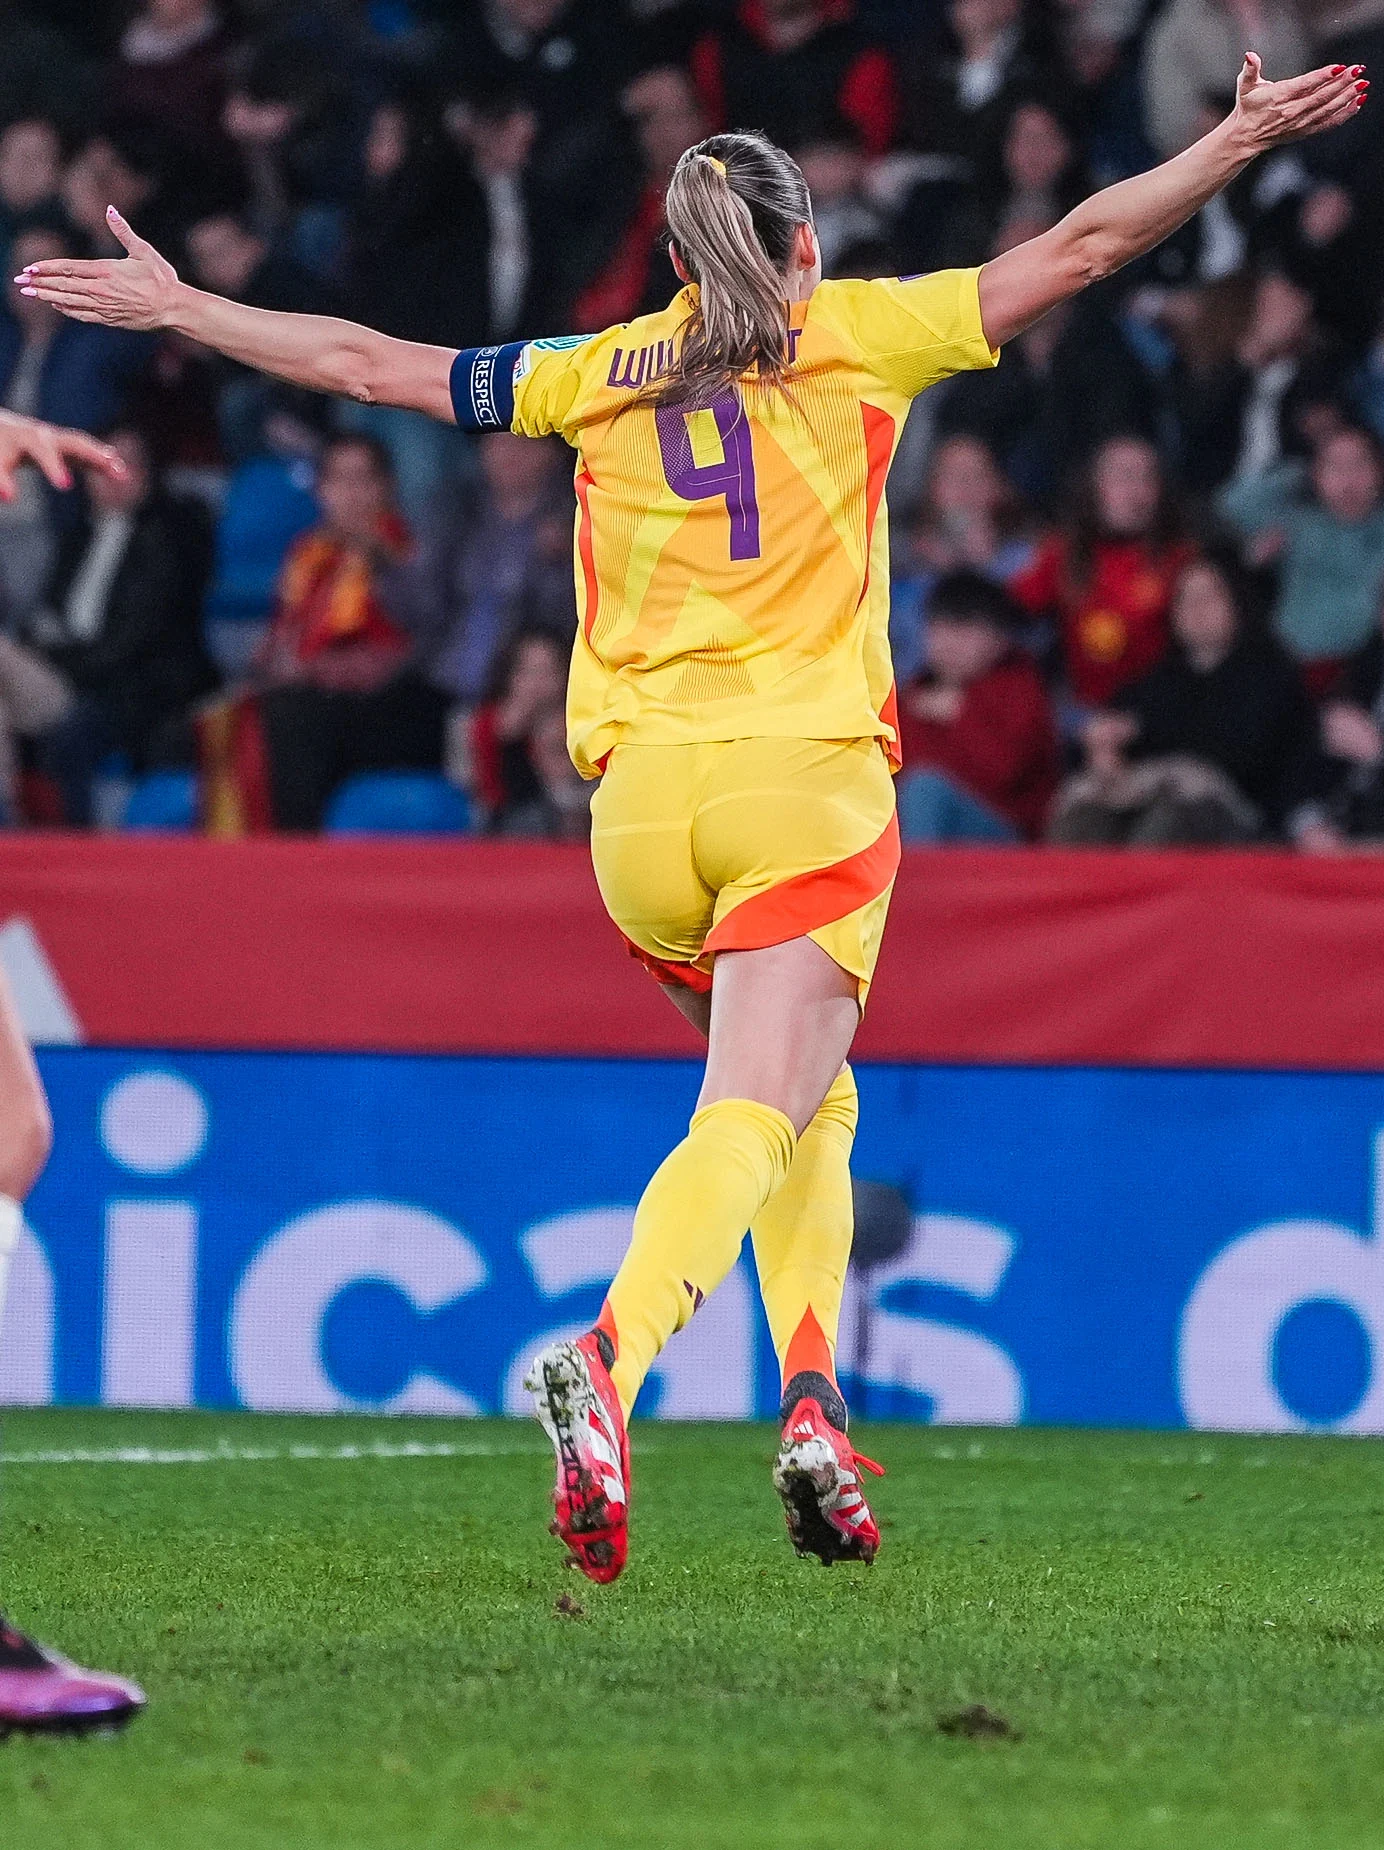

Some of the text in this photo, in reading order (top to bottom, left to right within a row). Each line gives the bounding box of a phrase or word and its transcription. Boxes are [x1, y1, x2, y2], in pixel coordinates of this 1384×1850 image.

[474, 359, 496, 426] RESPECT
[655, 385, 761, 561] 9
[0, 1070, 1025, 1427] icas
